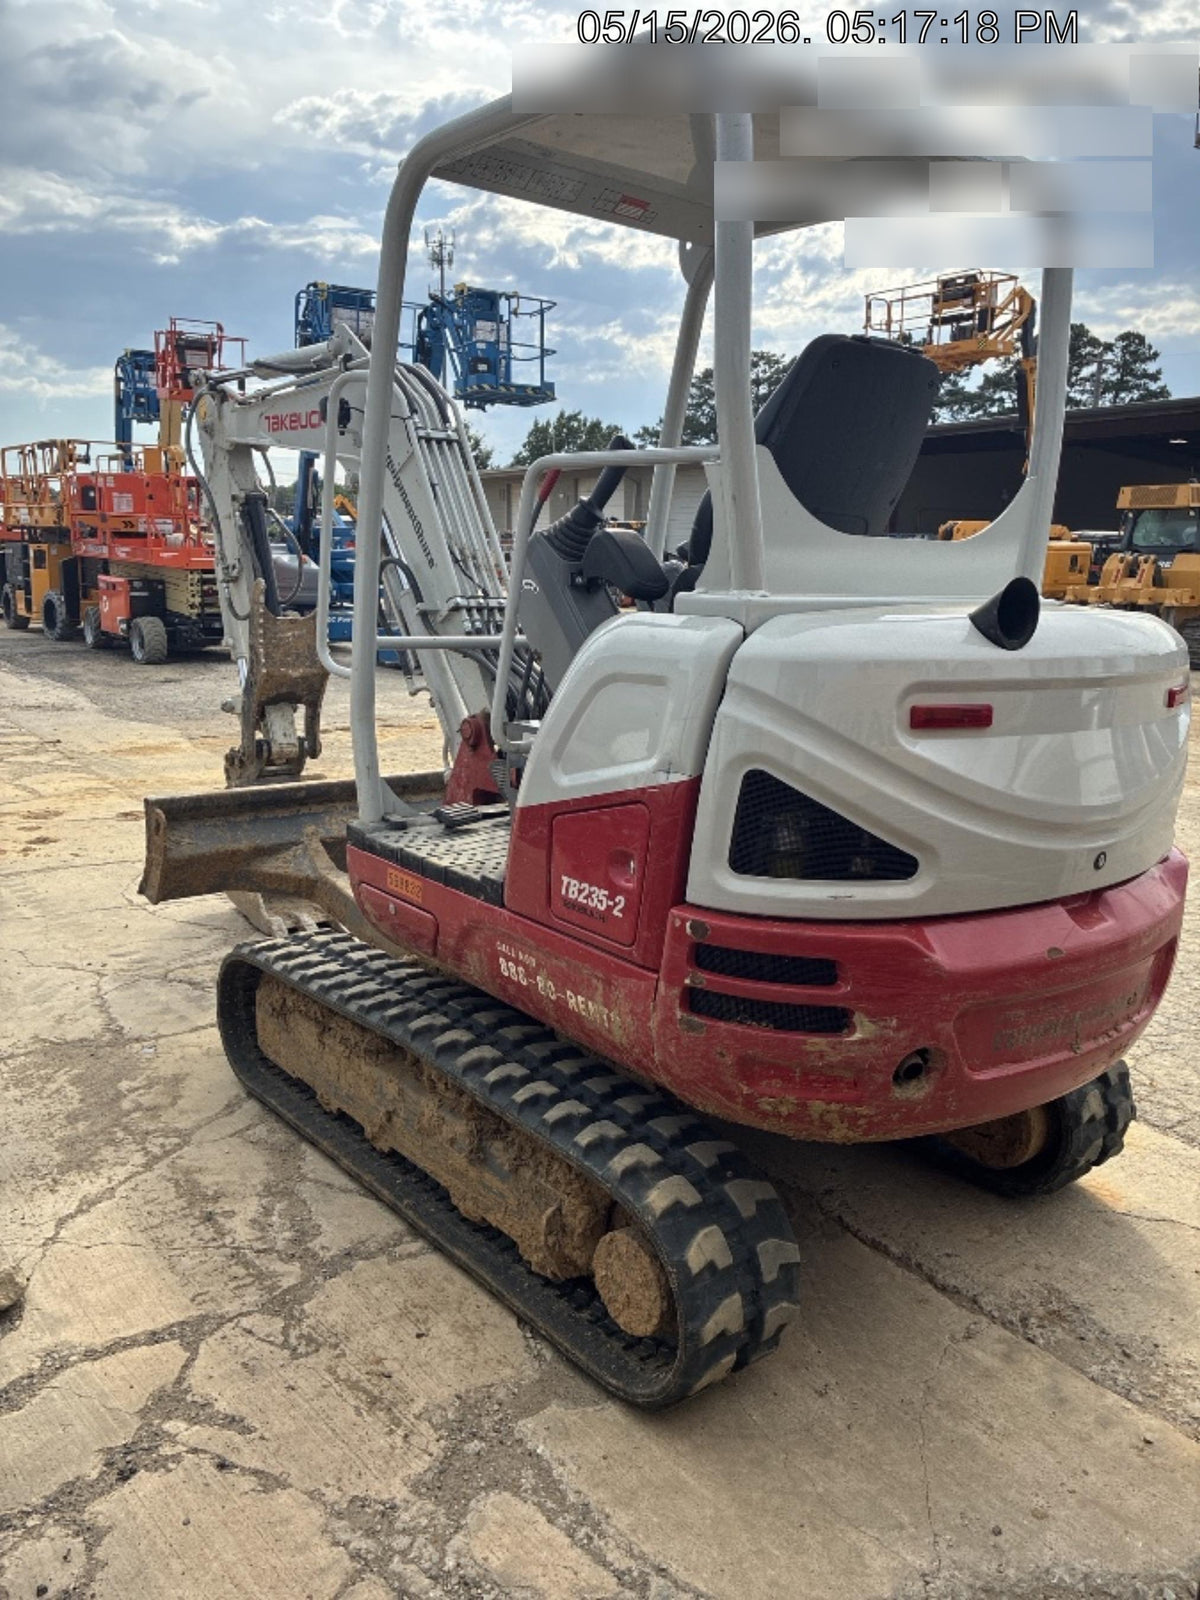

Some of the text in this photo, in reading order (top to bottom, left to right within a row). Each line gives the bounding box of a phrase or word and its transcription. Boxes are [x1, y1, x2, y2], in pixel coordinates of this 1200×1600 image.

[264, 409, 322, 433] TAKEUC
[386, 444, 436, 570] quipmentShare
[560, 875, 625, 918] TB235-2
